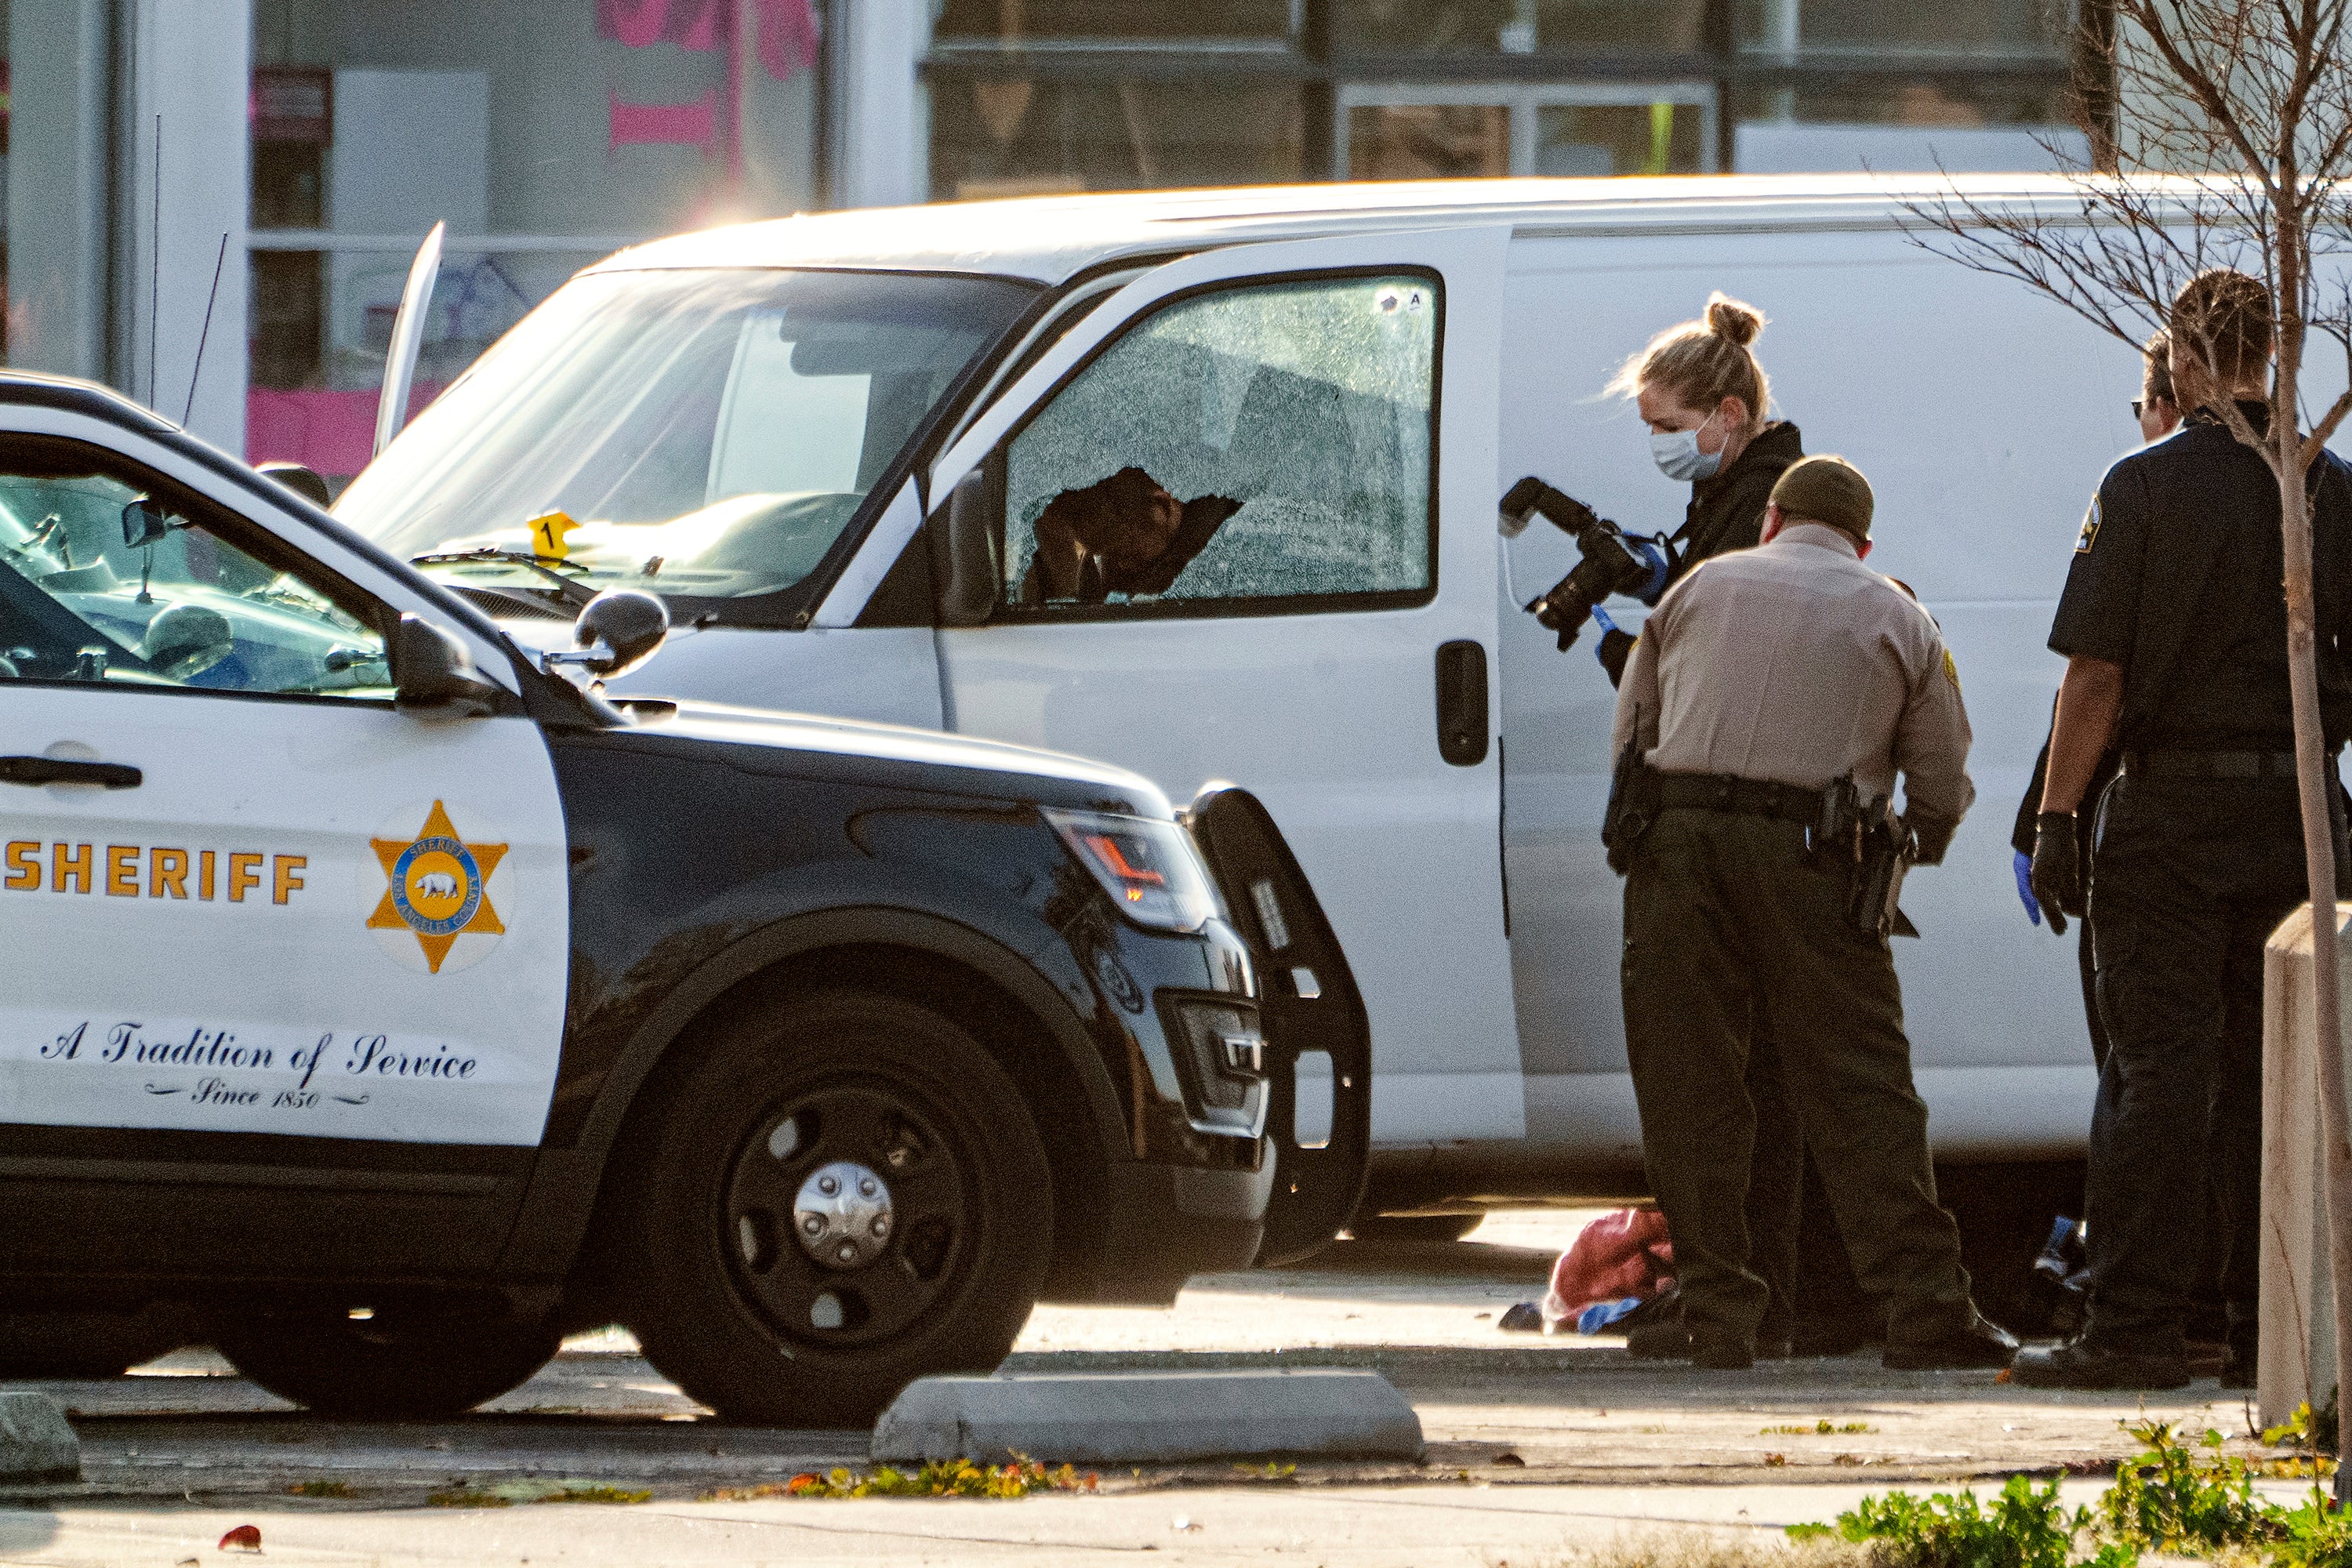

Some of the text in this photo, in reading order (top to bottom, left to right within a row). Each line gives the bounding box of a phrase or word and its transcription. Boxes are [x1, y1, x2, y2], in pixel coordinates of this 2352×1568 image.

[1411, 293, 1420, 304] A
[540, 522, 554, 550] 1
[410, 840, 464, 859] SHERIFF
[5, 840, 307, 905] SHERIFF
[41, 1022, 476, 1089] A Tradition of Service
[191, 1077, 320, 1109] Since 1850
